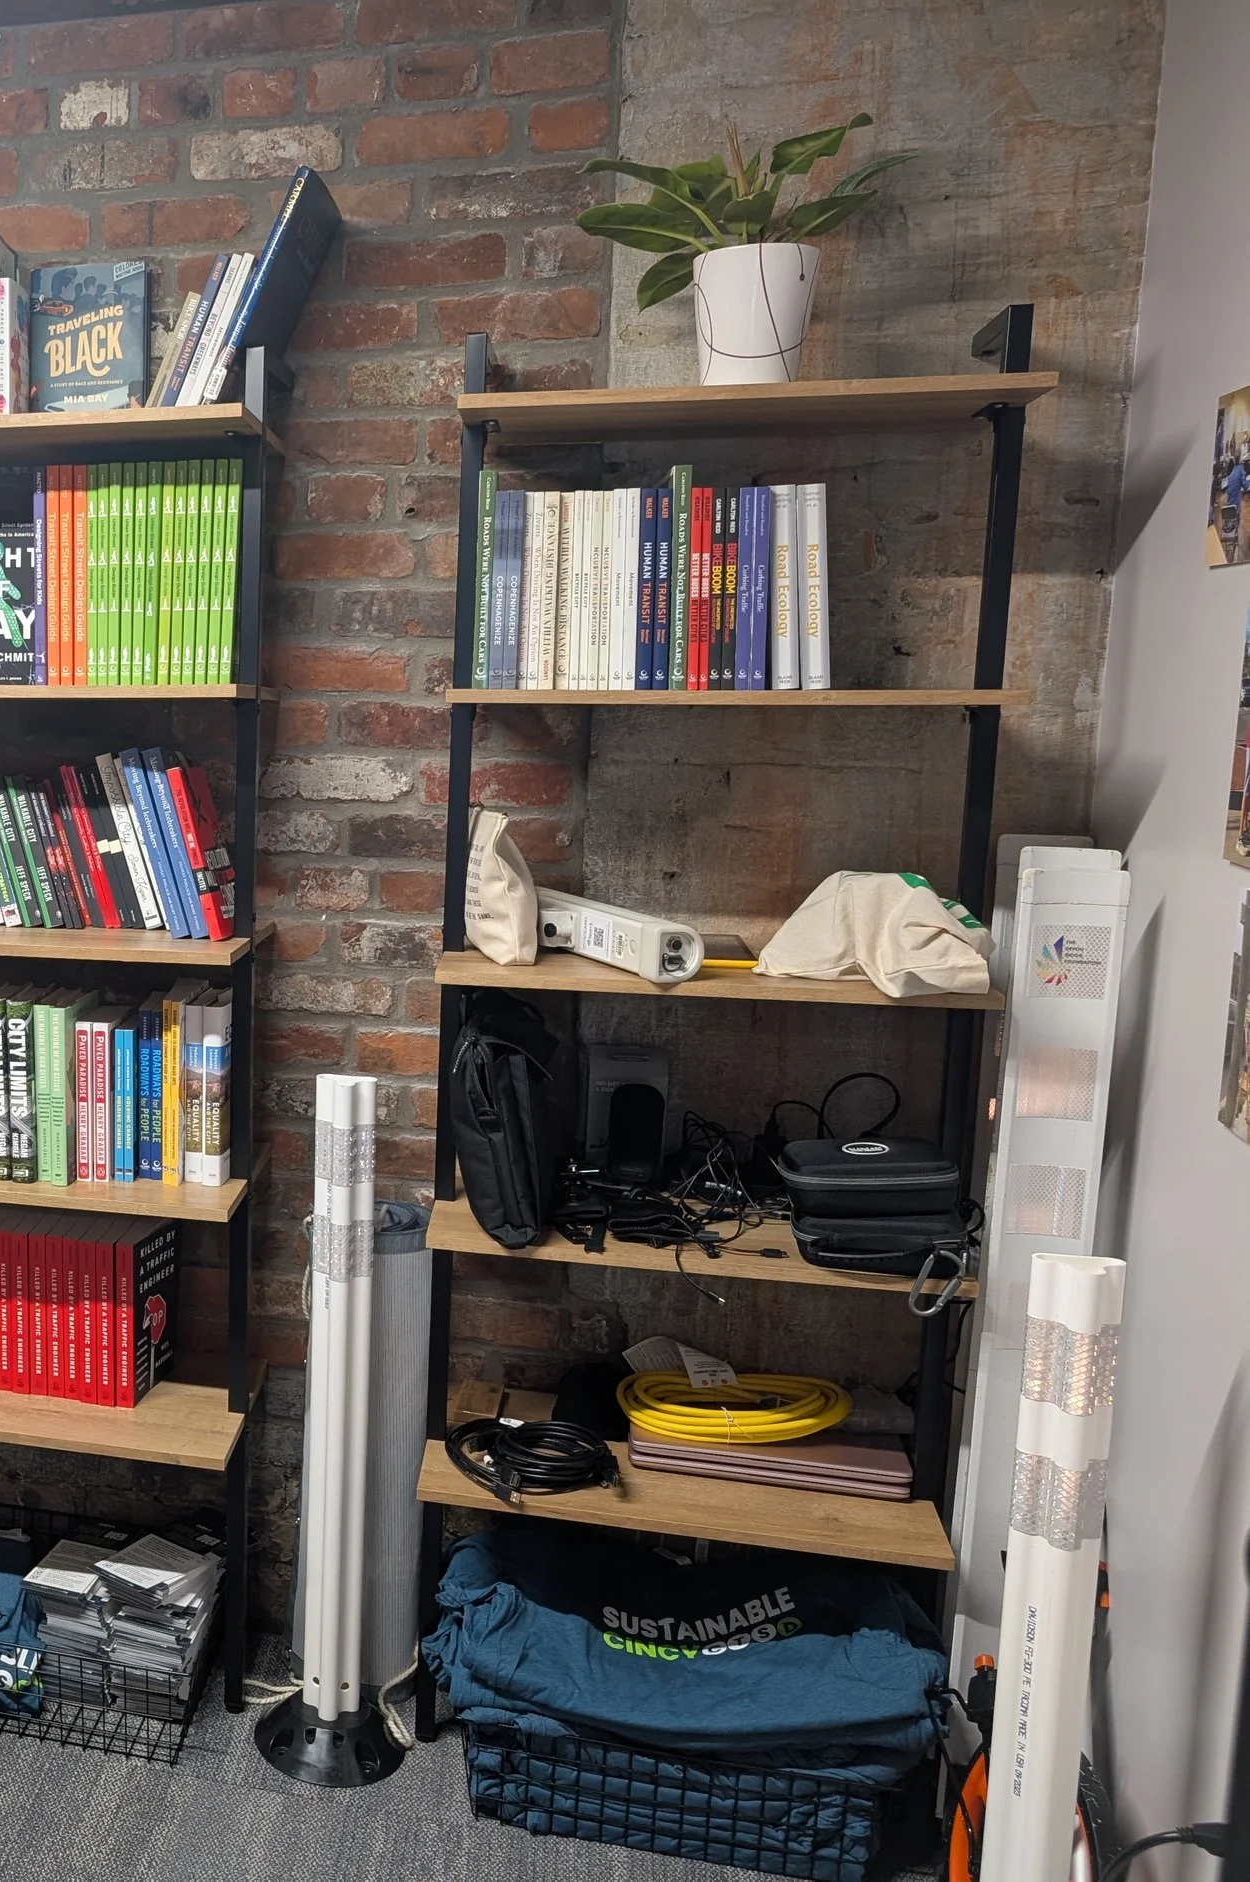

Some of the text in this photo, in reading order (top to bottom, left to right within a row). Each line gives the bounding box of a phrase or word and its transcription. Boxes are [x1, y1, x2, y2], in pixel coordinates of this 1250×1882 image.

[48, 305, 124, 336] TRAVELING
[175, 300, 209, 373] HUMAN TRANSIT
[189, 312, 218, 376] BEYOND GREENWAYS
[44, 321, 124, 378] BLACK
[63, 394, 109, 404] MIA BAY
[483, 516, 492, 546] ROADS
[542, 521, 557, 656] WITHIN WALKING DISTANCE
[641, 542, 653, 624] HUMAN TRANSIT
[701, 578, 710, 598] BUSES
[702, 553, 710, 577] BETTER
[741, 564, 750, 613] Curbing Traffic
[494, 576, 503, 645] COPENHAGENIZE
[508, 576, 517, 645] COPENHAGENIZE
[775, 544, 791, 638] Road Ecology
[806, 544, 822, 638] Road Ecology
[478, 641, 487, 663] CARS
[127, 756, 158, 849] Moving Beyond Icebreakers
[6, 827, 16, 842] CITY
[119, 820, 133, 846] City
[15, 865, 32, 902] JEFF SPECK
[8, 1019, 29, 1119] CITY LIMITS
[78, 1034, 87, 1098] PAVED PARADISE
[95, 1035, 105, 1099] PAVED PARADISE
[140, 1048, 150, 1096] ROADWAYS
[140, 1109, 150, 1142] PEOPLE
[191, 1100, 200, 1143] EQUALITY
[140, 1236, 164, 1259] KILLED
[146, 1247, 175, 1271] TRAFFIC
[139, 1264, 175, 1294] ENGINEER
[602, 1586, 796, 1641] SUSTAINABLE
